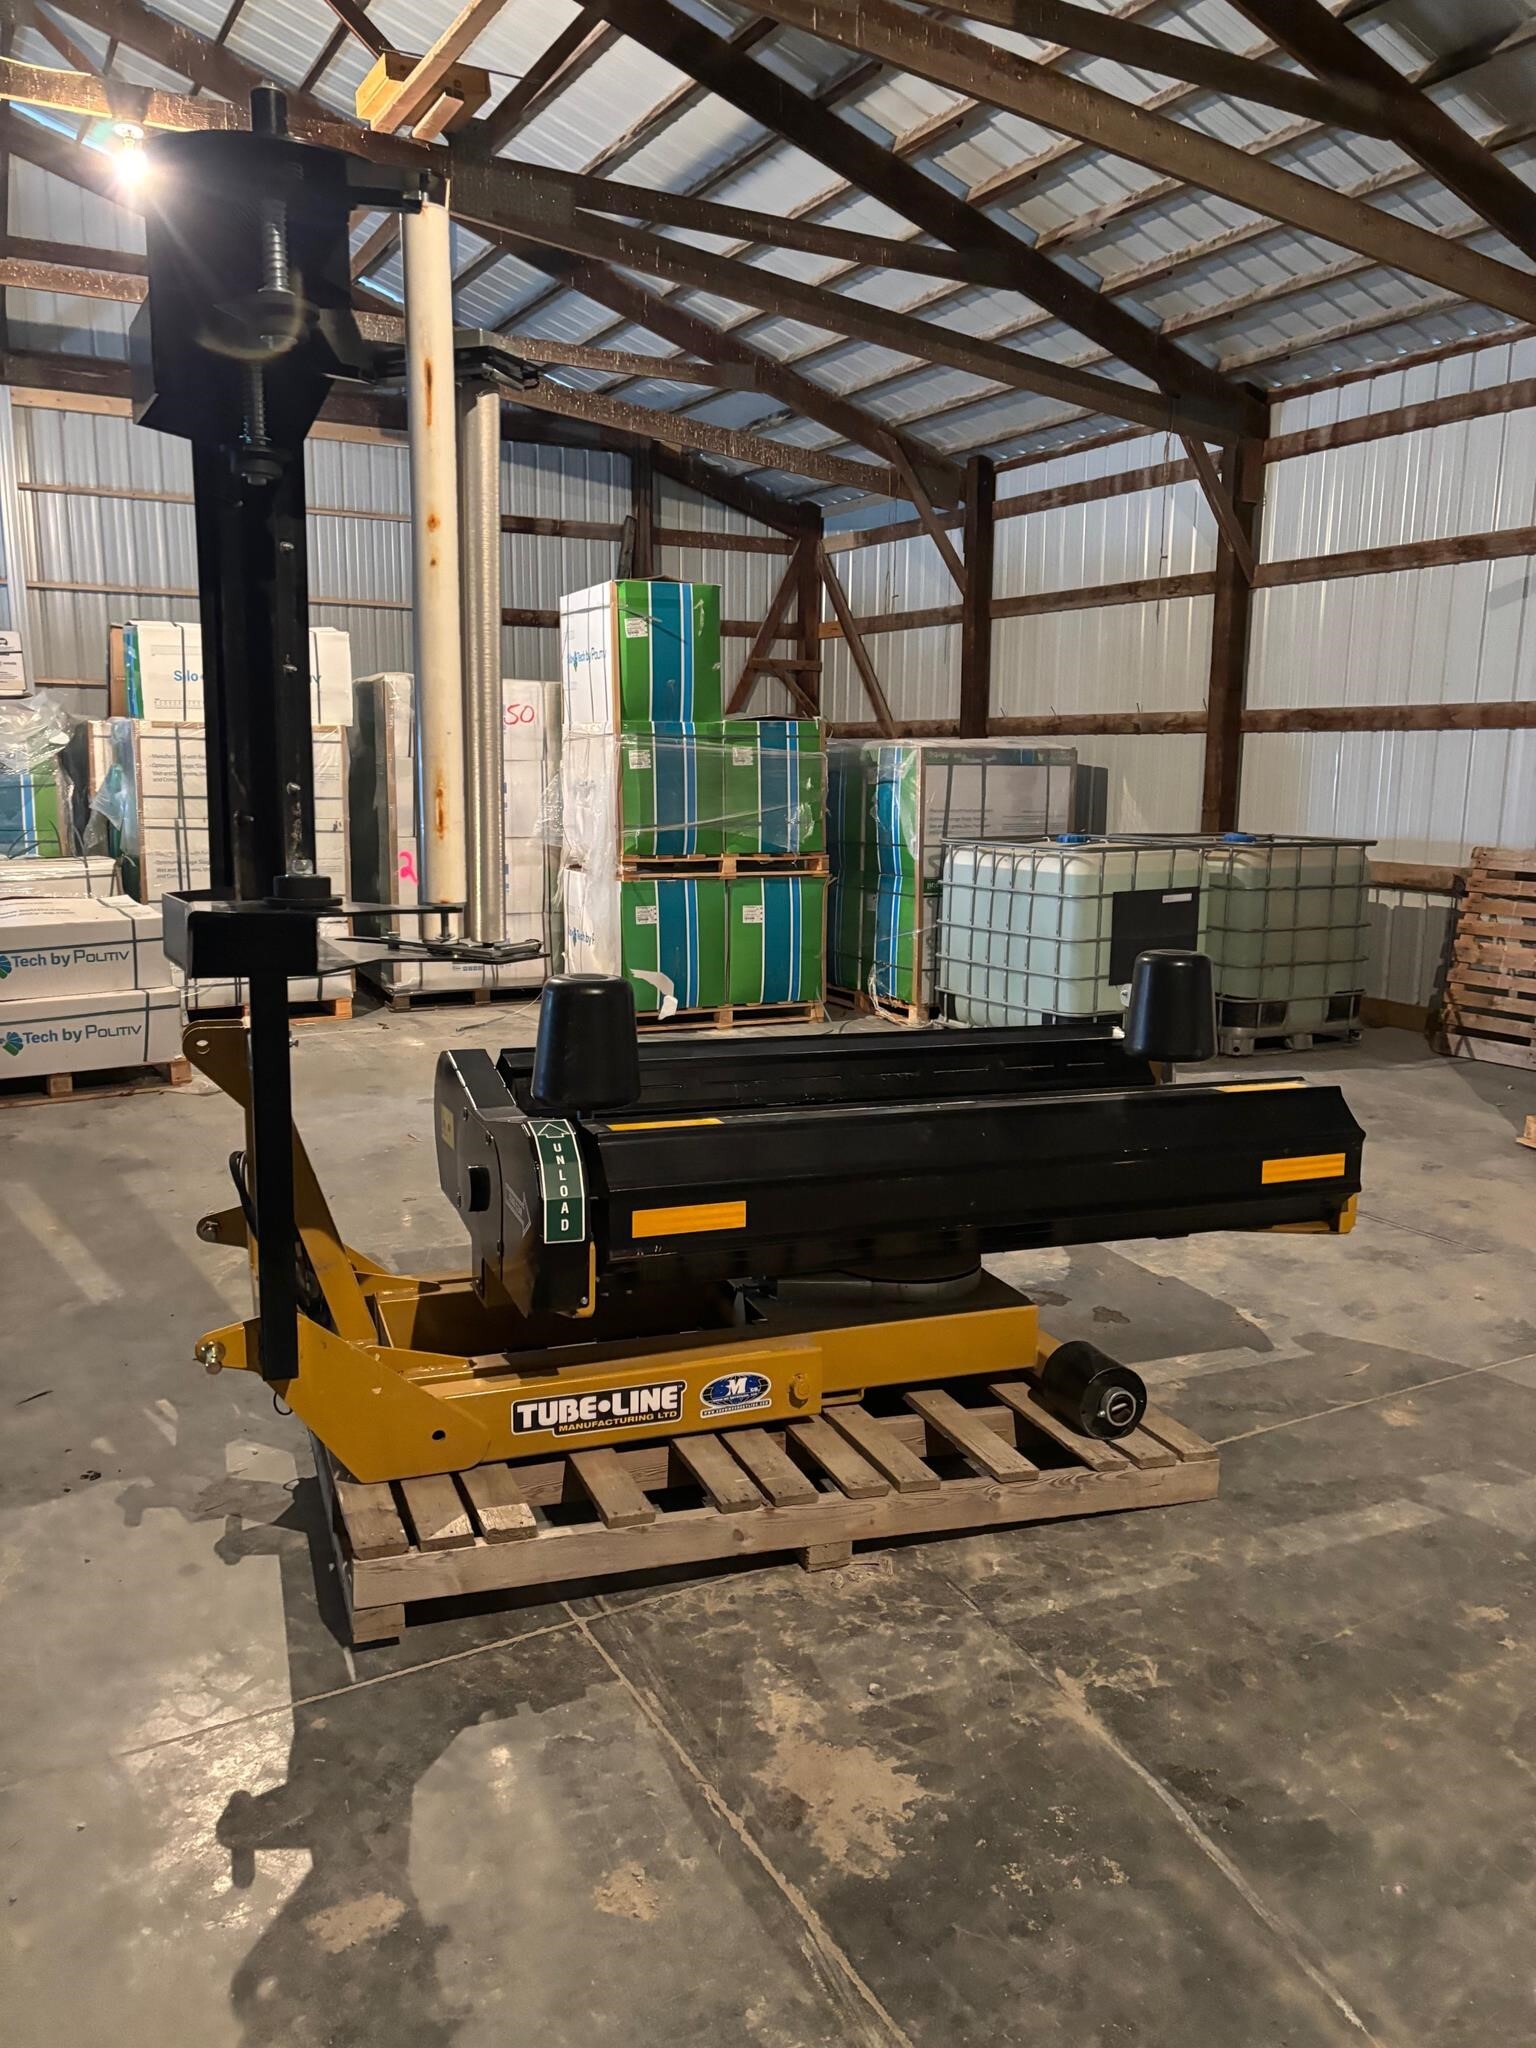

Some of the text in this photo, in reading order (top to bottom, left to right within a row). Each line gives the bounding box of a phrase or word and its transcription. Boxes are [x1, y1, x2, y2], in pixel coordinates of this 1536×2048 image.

[504, 704, 535, 725] 50
[397, 851, 419, 887] 2
[11, 954, 48, 968] Tech
[51, 952, 70, 967] by
[22, 1030, 59, 1044] Tech
[62, 1028, 82, 1043] by
[552, 1142, 570, 1232] UNLOAD
[558, 1409, 678, 1433] MANUFACTURING LTD
